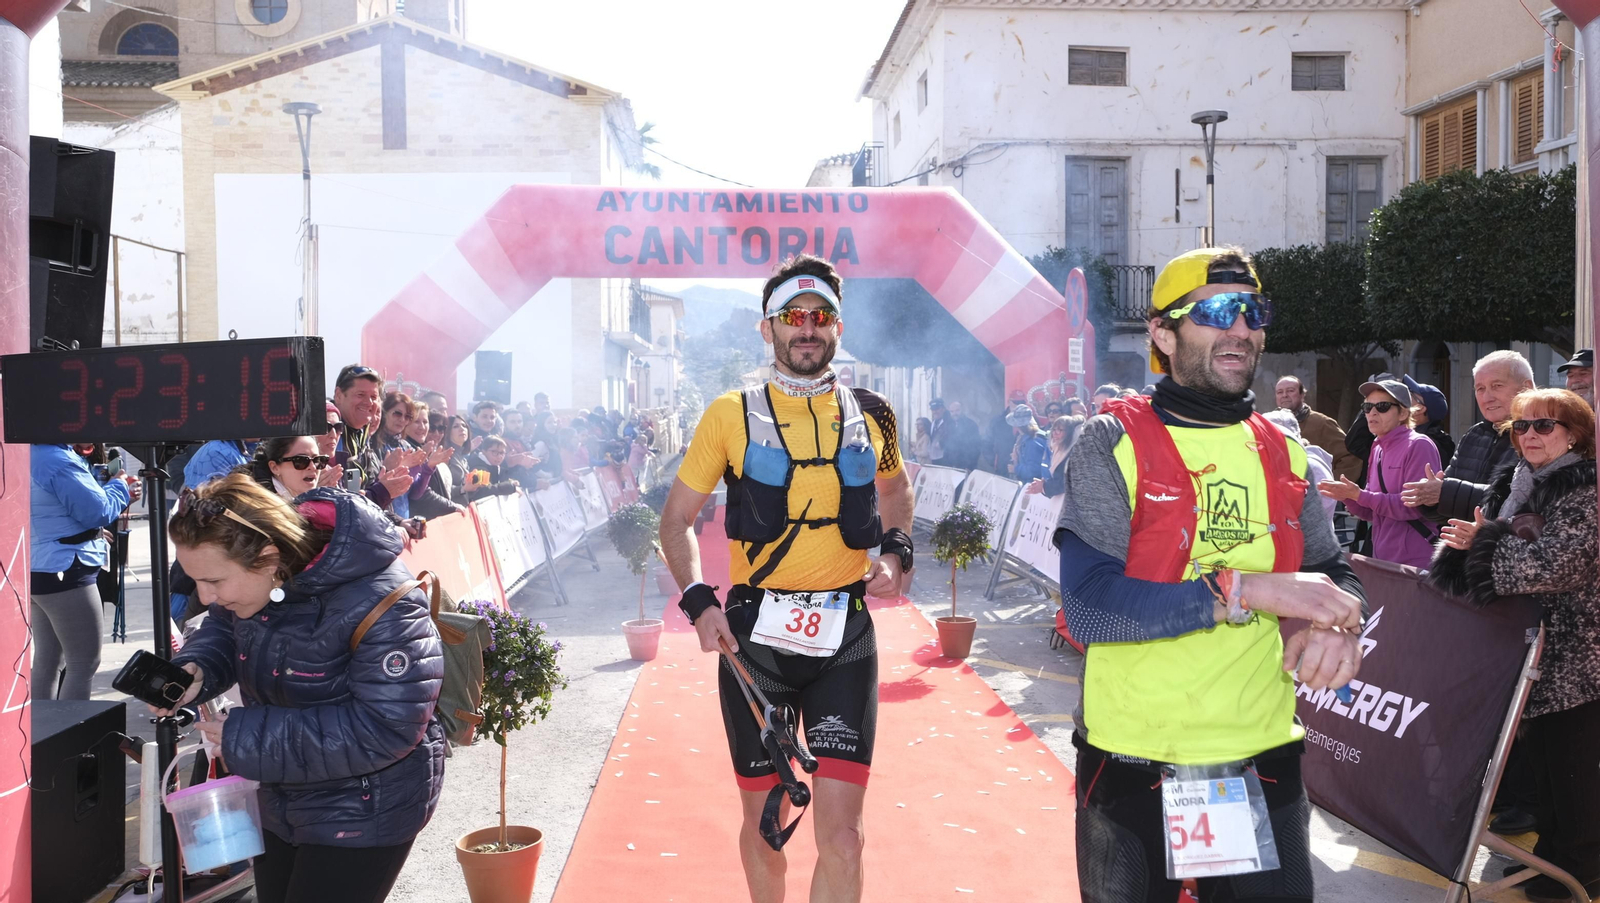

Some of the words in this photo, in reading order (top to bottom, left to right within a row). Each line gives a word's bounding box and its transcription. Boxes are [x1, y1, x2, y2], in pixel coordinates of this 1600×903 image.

[596, 190, 869, 213] AYUNTAMIENTO
[604, 226, 859, 265] CANTORIA
[59, 348, 298, 432] 3:23:16
[785, 607, 822, 638] 38
[1296, 678, 1430, 739] AMERGY
[808, 741, 857, 752] MARATON
[1167, 812, 1215, 851] 54
